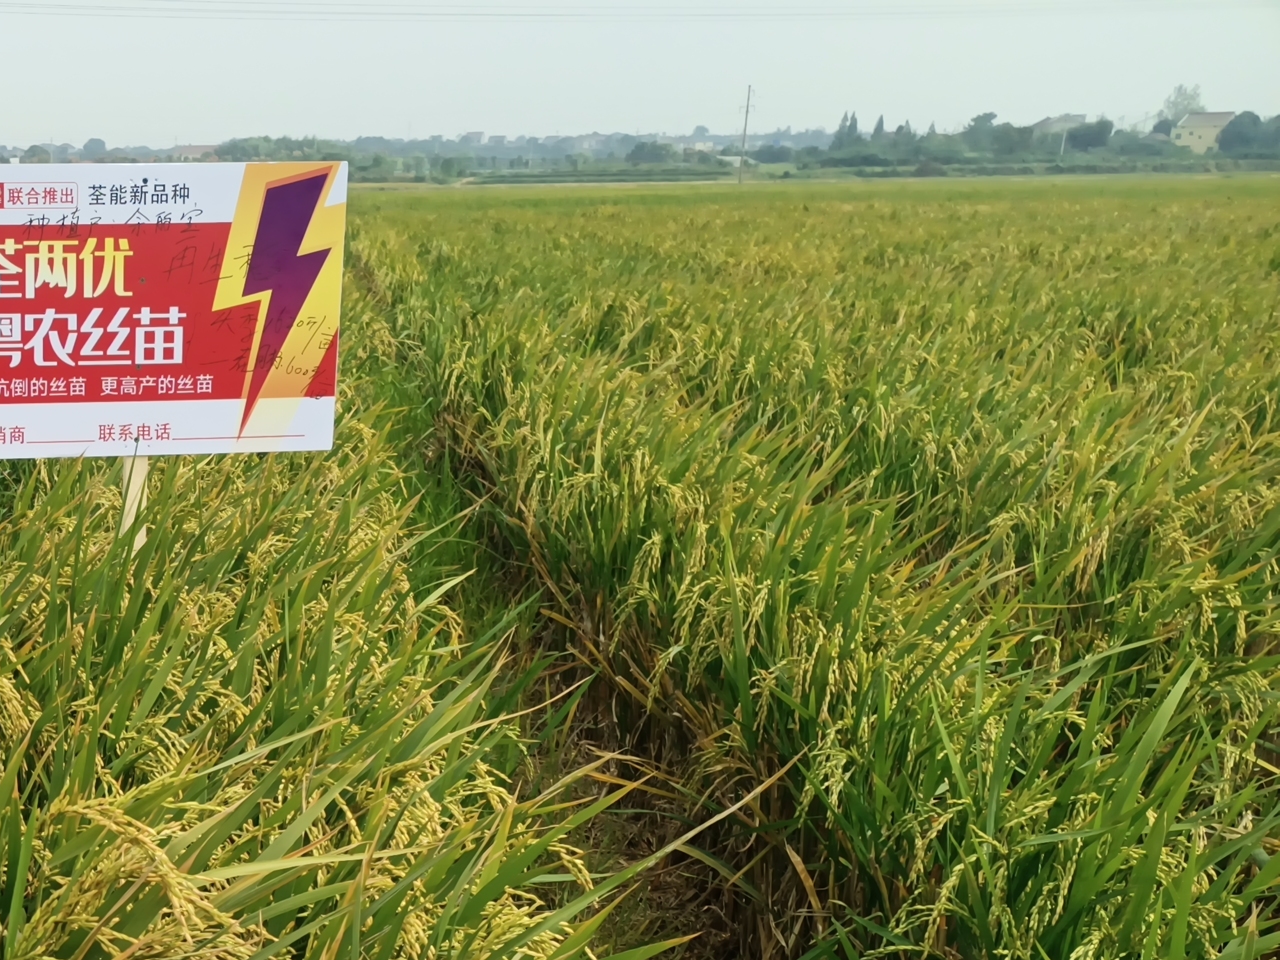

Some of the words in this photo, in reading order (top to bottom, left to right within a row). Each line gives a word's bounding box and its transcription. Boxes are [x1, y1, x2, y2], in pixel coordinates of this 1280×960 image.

[7, 187, 75, 206] 联合推出
[88, 182, 190, 206] 荃能新品种
[100, 374, 214, 396] 更高产的丝苗
[98, 422, 172, 443] 联系电话
